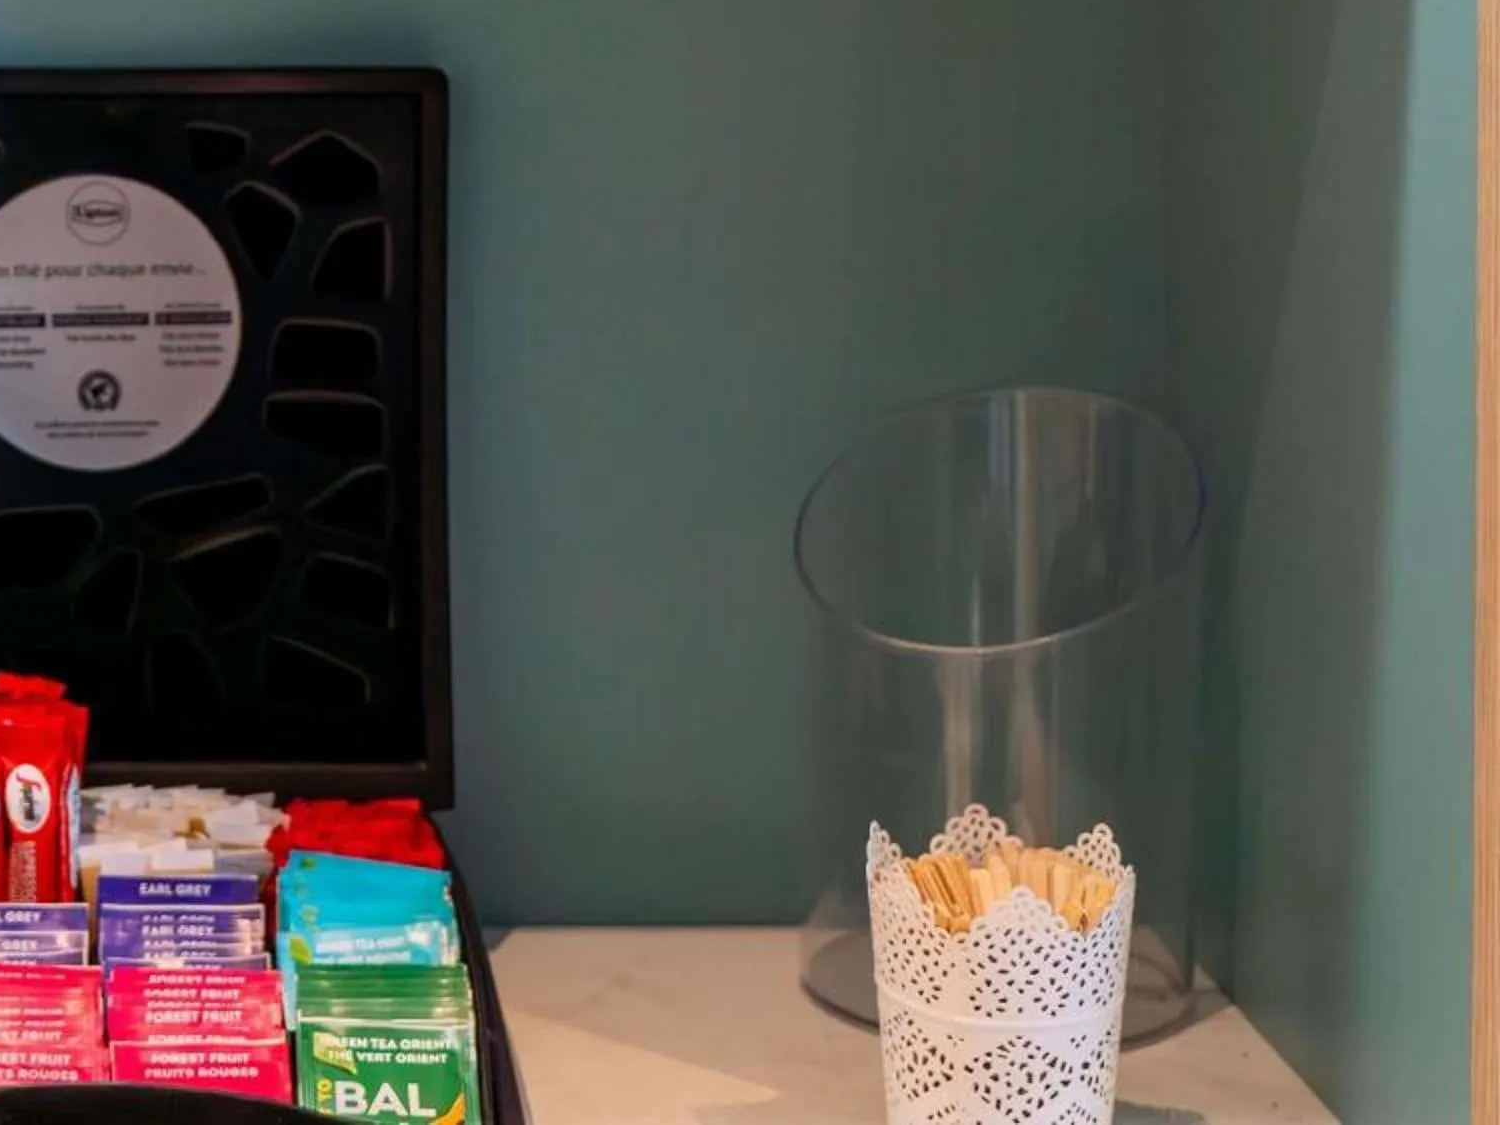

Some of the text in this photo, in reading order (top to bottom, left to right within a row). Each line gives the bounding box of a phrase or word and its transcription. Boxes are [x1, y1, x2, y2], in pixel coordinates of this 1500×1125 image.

[45, 264, 83, 280] pour
[86, 262, 146, 280] chaque
[139, 882, 213, 895] EARL GREY
[4, 910, 41, 923] GREY
[369, 1036, 397, 1049] TEA
[400, 1037, 452, 1050] ORIENT
[209, 1052, 250, 1064] FRUIT
[356, 1051, 392, 1063] VERT
[395, 1051, 448, 1064] ORIENT
[335, 1079, 437, 1118] BAL
